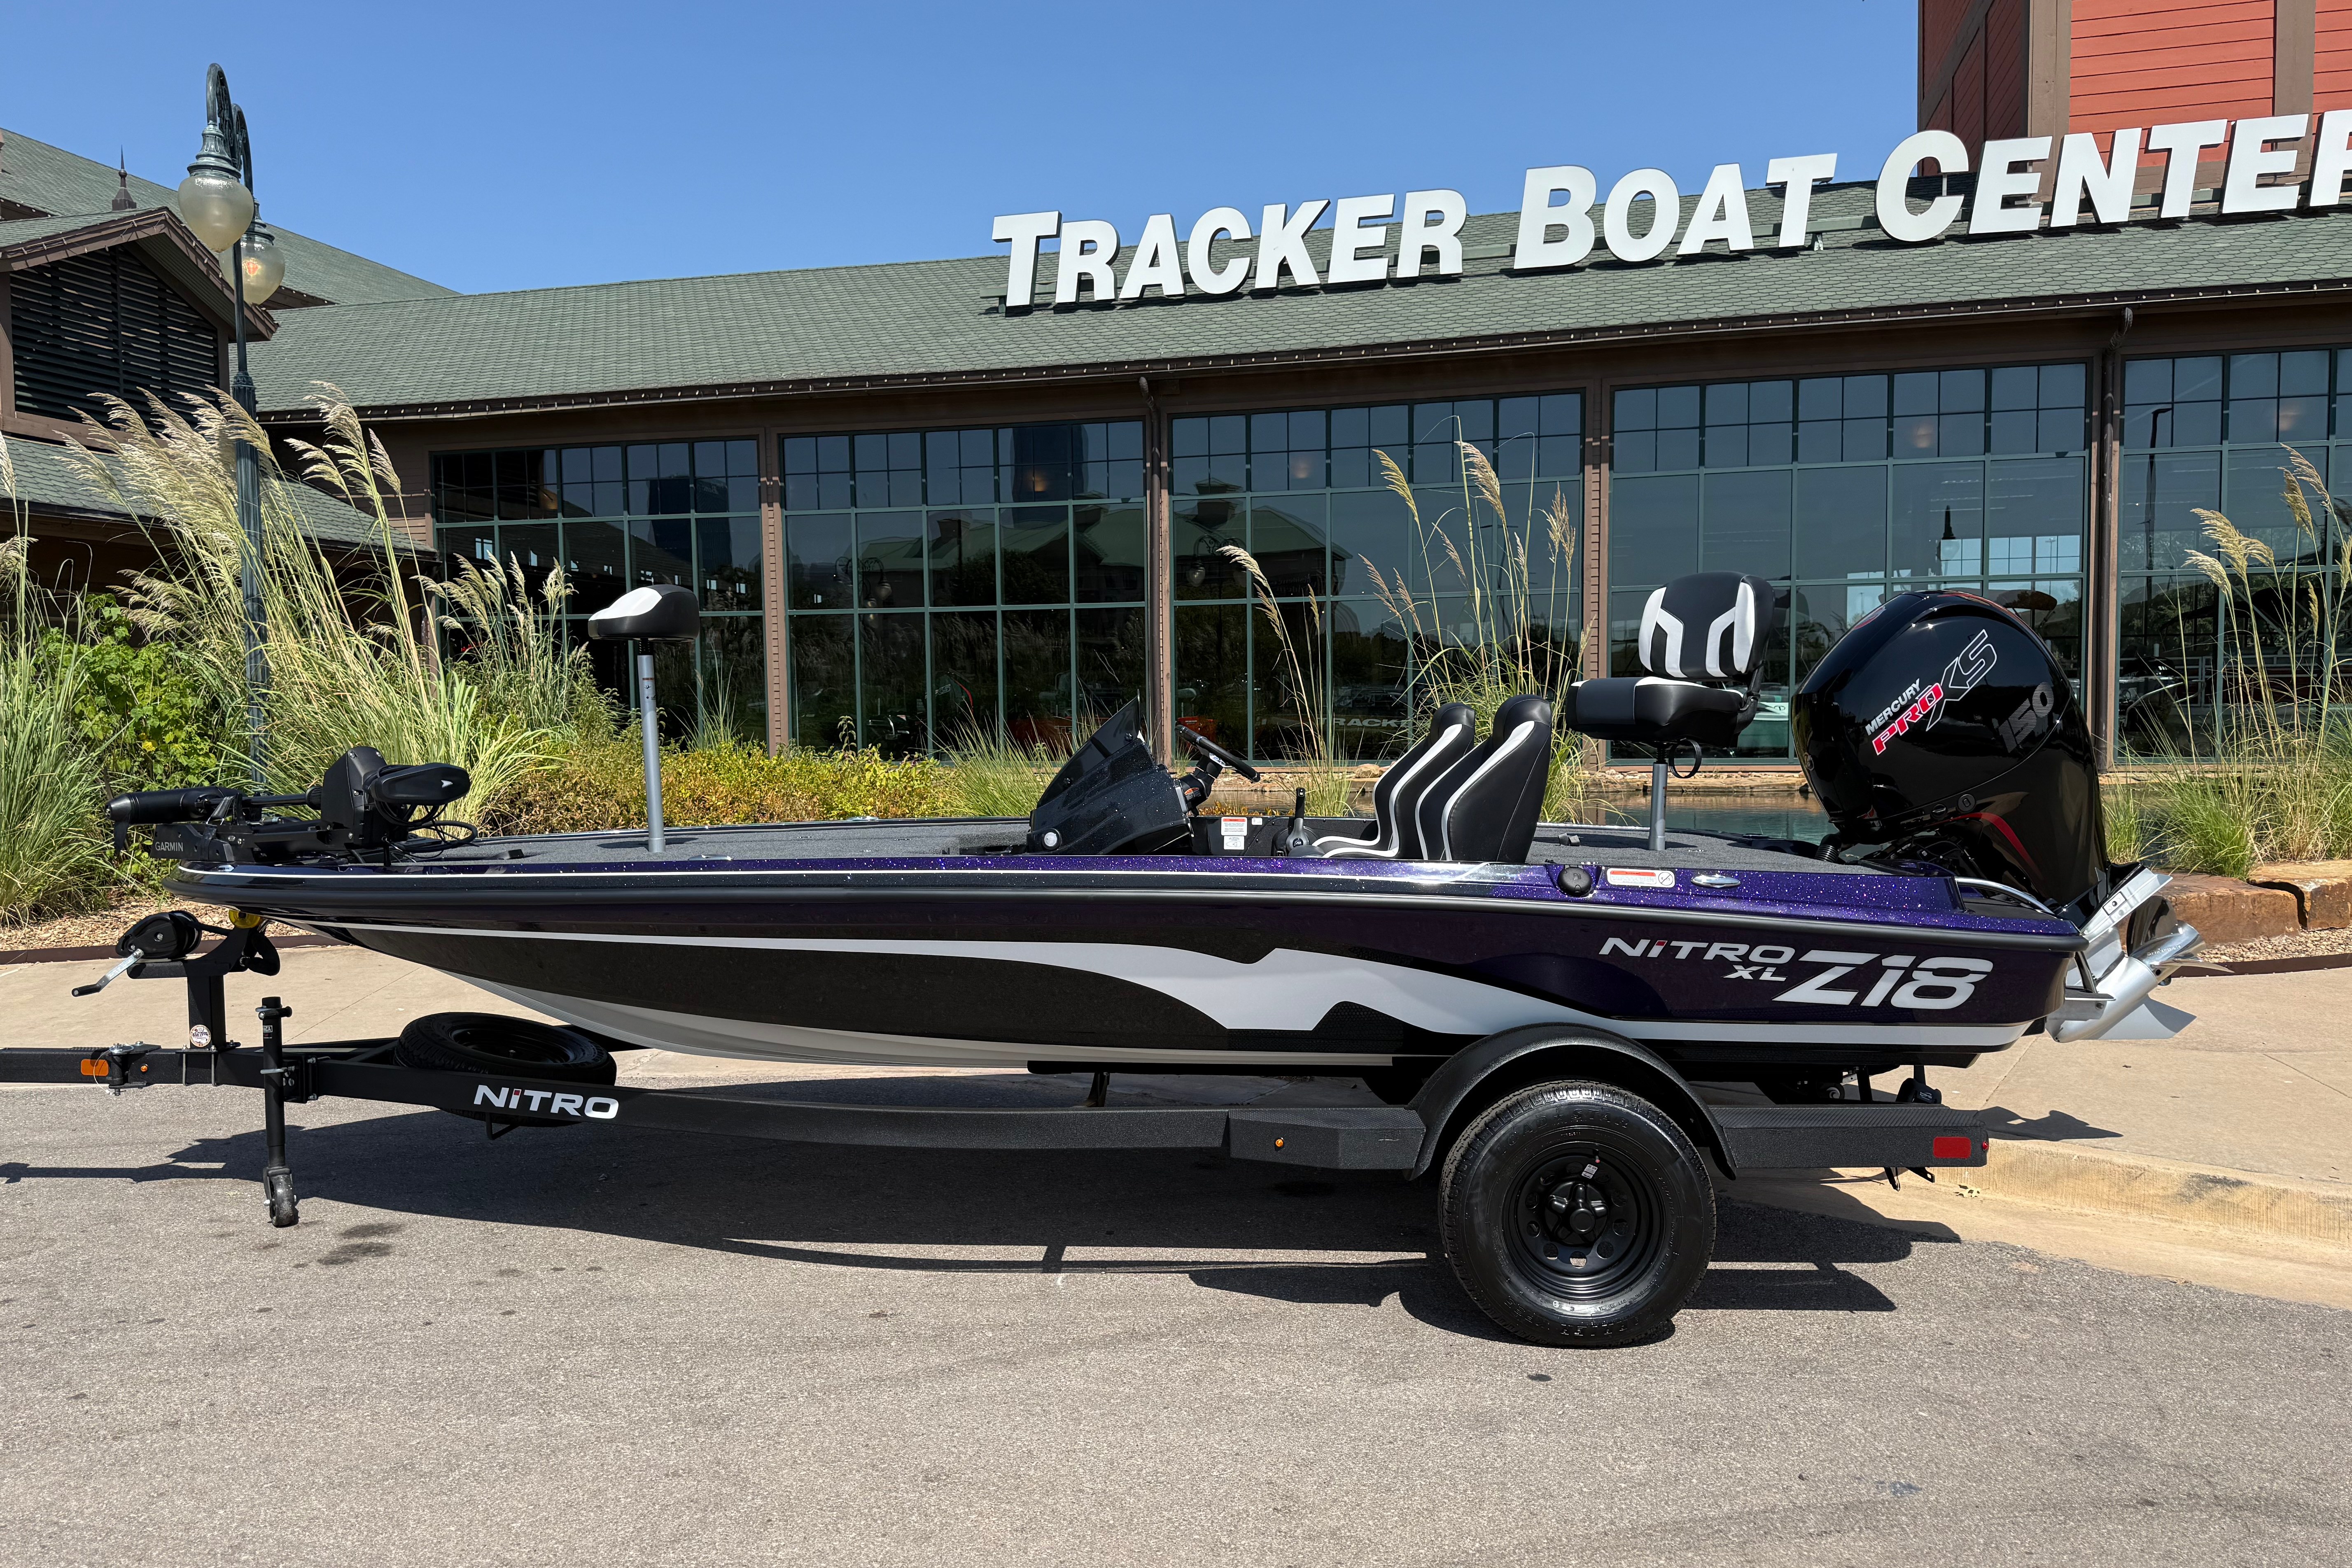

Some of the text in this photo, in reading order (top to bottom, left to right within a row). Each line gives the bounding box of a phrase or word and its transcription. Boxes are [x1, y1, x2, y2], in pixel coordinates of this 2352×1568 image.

[992, 189, 1467, 307] TRACKER
[1514, 153, 1837, 269] BOAT
[1865, 678, 1920, 736] MERCURY
[1872, 629, 1997, 756] PRO XS
[1998, 681, 2054, 753] 150
[155, 841, 184, 852] GARMIN
[1720, 964, 1788, 982] XL
[1772, 950, 1994, 1010] Z18
